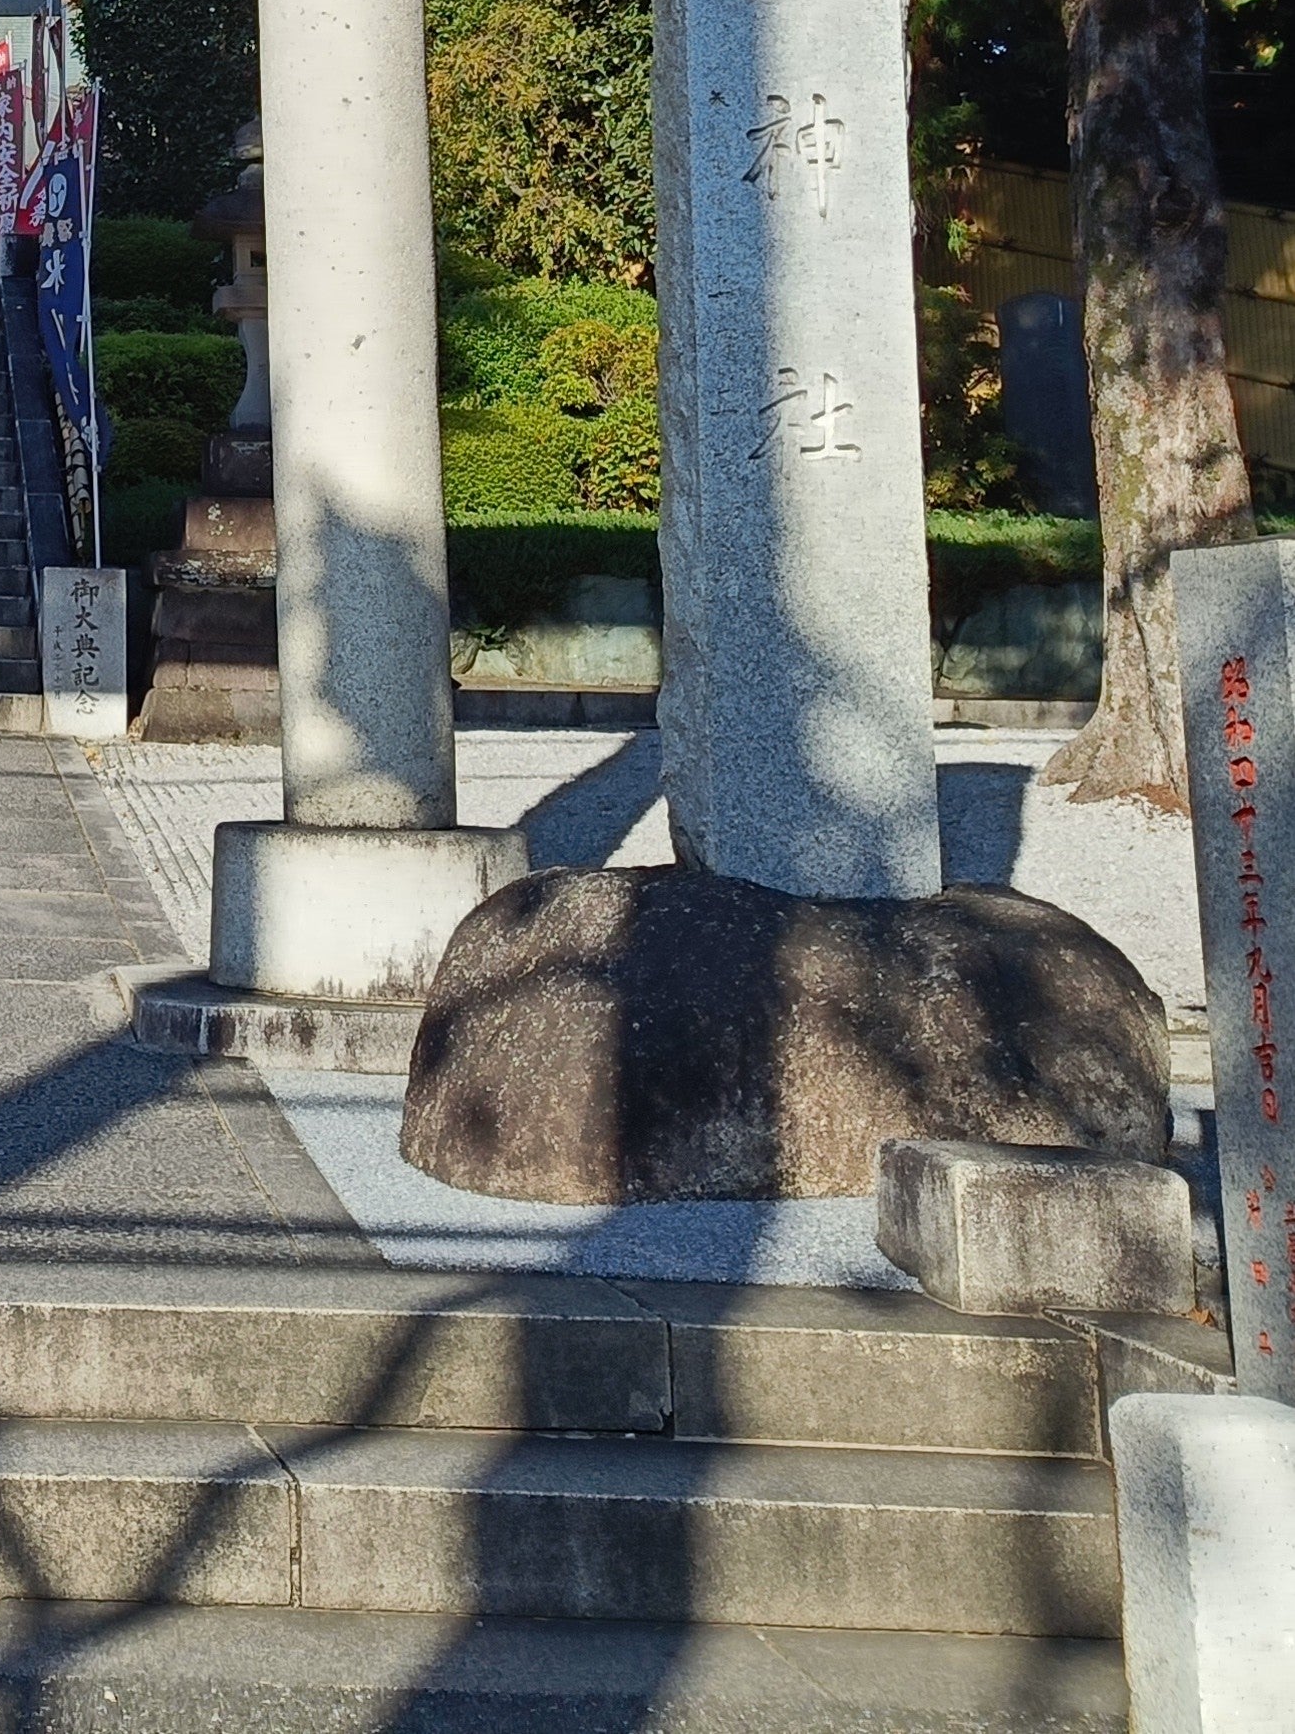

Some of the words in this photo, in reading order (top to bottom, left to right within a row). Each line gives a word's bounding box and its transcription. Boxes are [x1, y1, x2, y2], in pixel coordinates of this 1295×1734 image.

[70, 578, 100, 715] 御大典記念
